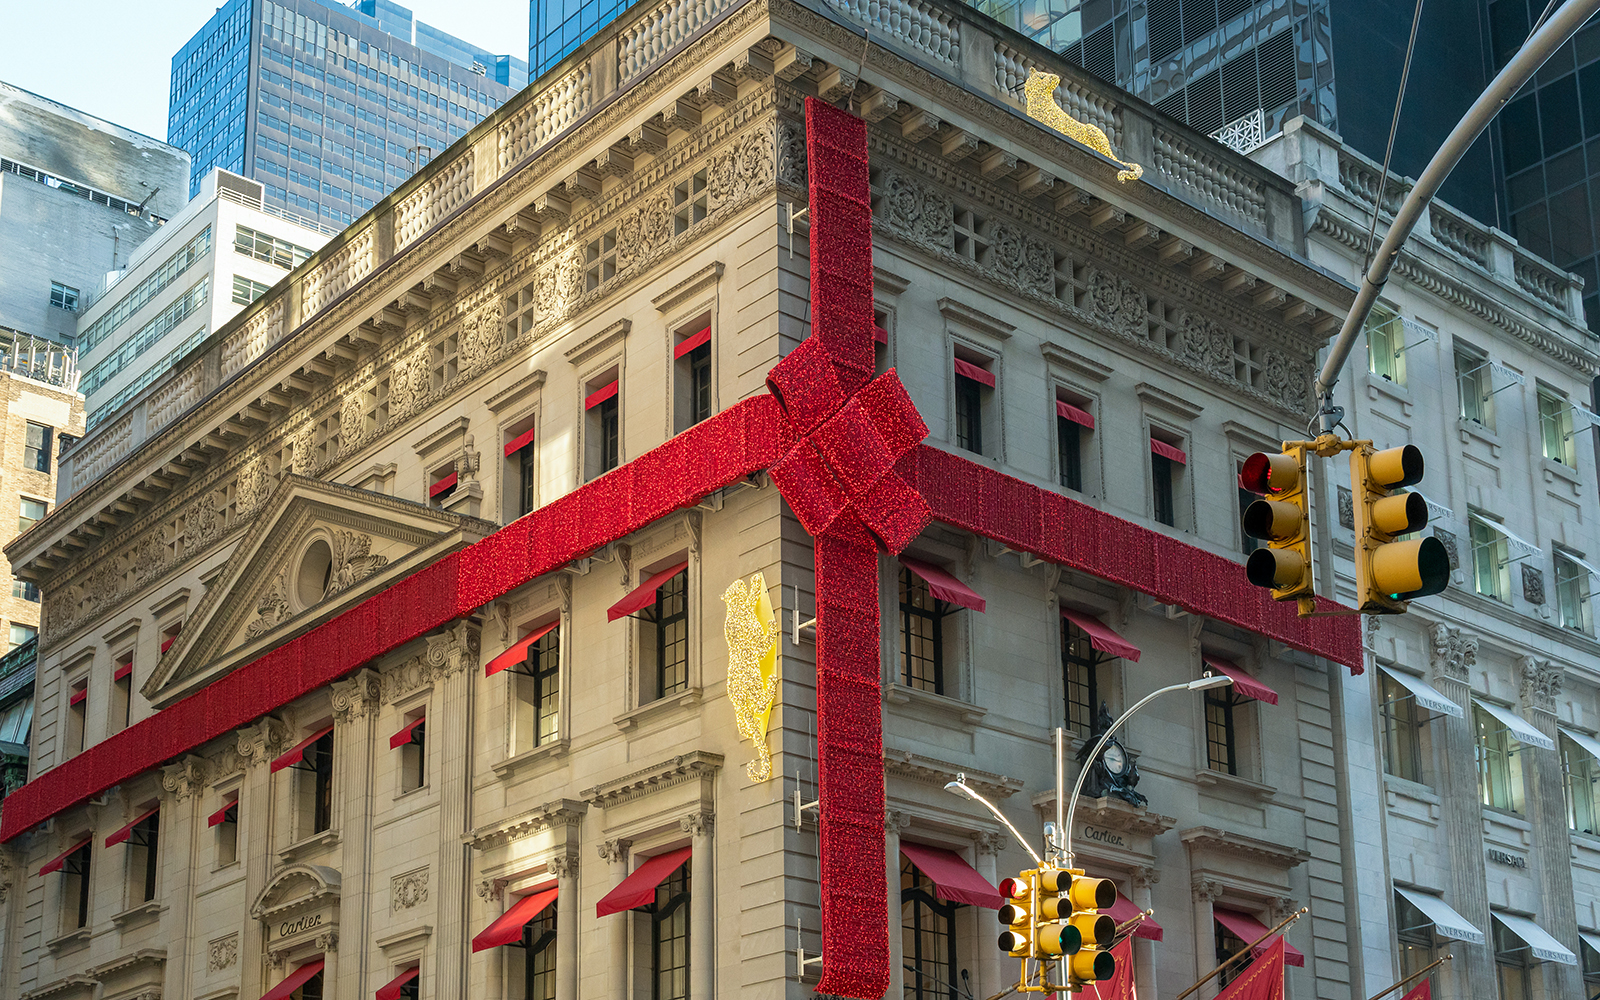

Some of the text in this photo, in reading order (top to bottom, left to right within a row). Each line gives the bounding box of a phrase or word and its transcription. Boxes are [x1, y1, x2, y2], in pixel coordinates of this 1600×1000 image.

[1429, 503, 1450, 518] RSACE
[1424, 698, 1455, 714] VERSACE
[1518, 732, 1547, 747] VERSACE
[1085, 826, 1124, 846] Cartier
[1488, 849, 1528, 868] VERSACE
[280, 914, 321, 937] Cartier
[1444, 926, 1475, 941] VERSACE
[1540, 949, 1569, 962] VERSACE
